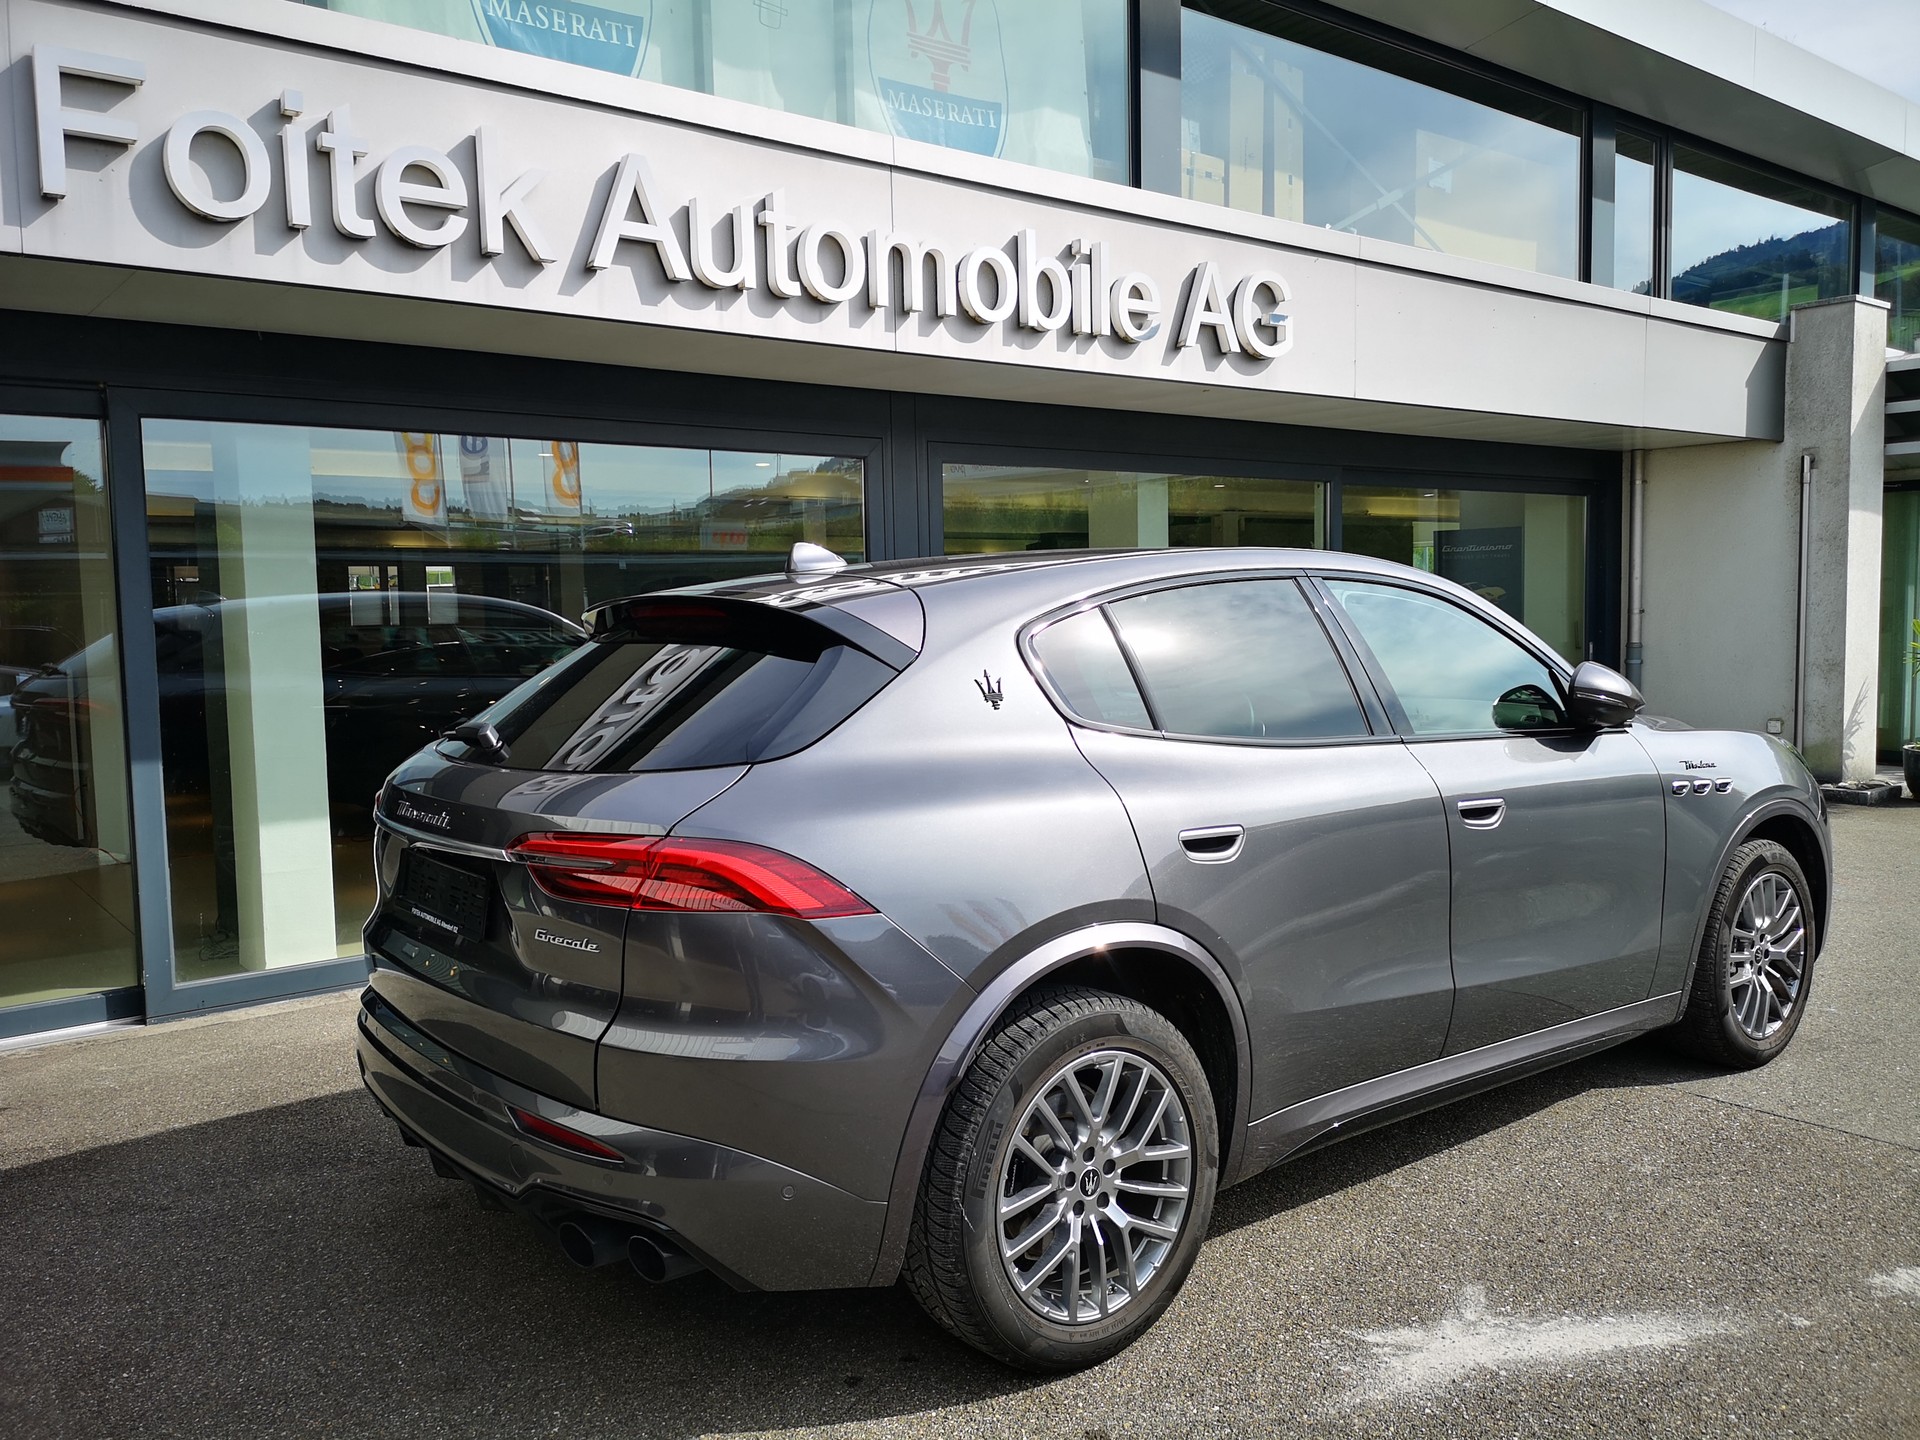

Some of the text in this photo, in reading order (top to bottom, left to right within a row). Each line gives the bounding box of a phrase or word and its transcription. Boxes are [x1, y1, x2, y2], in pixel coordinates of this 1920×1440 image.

[487, 0, 636, 48] MASERATI
[887, 89, 997, 129] MASERATI
[33, 44, 1293, 360] Foitek Automobile AG
[534, 928, 601, 953] Grecale
[970, 1119, 1004, 1200] PIRELLI
